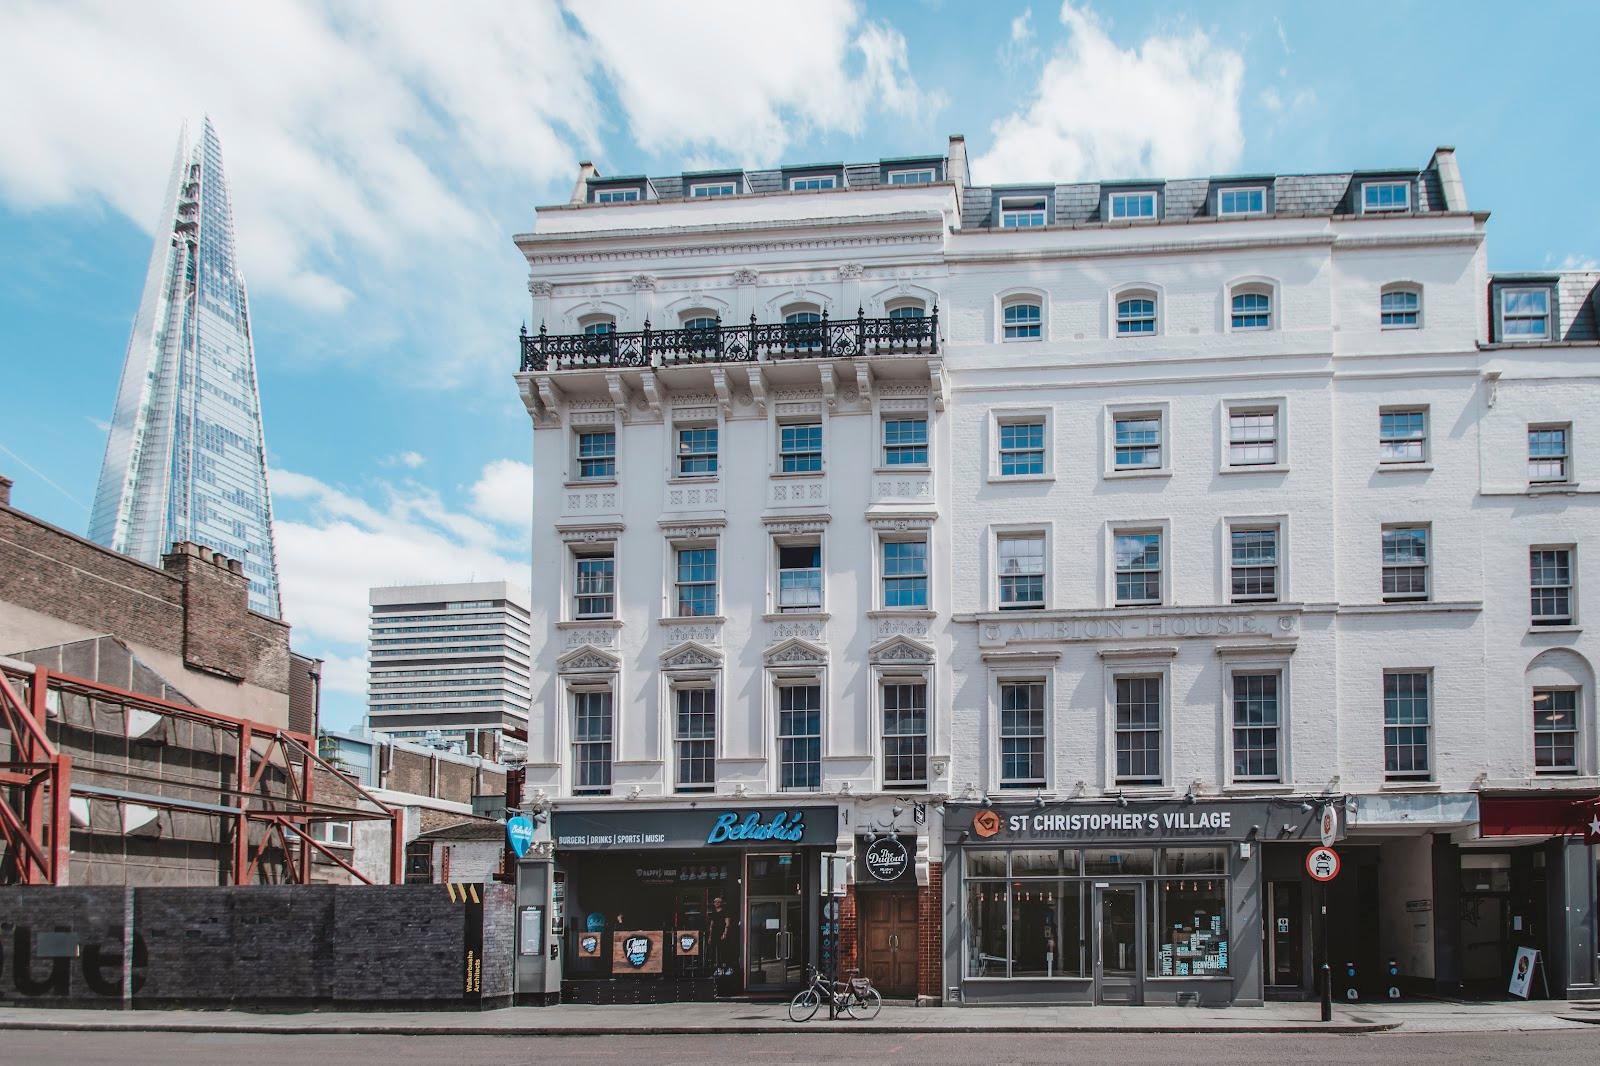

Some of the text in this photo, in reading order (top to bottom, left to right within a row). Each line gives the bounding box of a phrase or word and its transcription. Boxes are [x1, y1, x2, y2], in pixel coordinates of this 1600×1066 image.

[1008, 617, 1124, 640] ALBION
[708, 811, 807, 845] Belushi's
[1009, 812, 1231, 831] ST CHRISTOPHER'S VILLAGE
[558, 834, 665, 845] BURGERS DRINKS SPORTS MUSIC
[868, 853, 905, 867] Dugout
[880, 849, 894, 857] The
[1162, 944, 1173, 976] WELCOME
[1218, 941, 1228, 969] WELCOME
